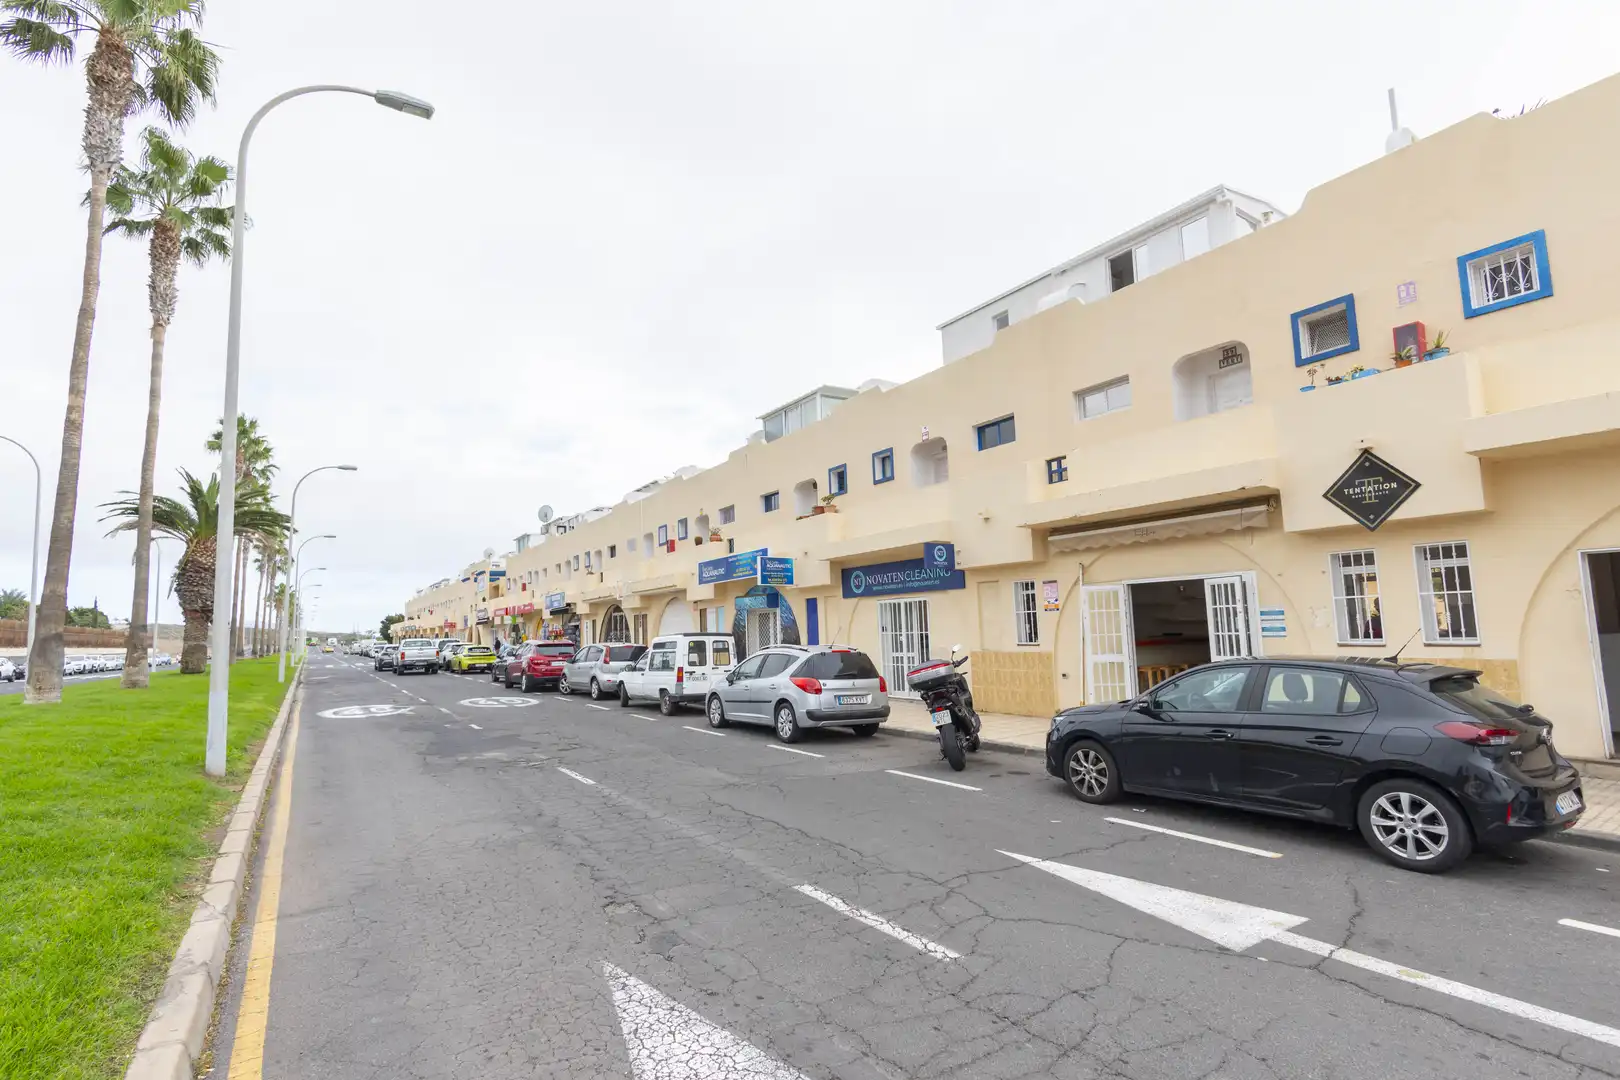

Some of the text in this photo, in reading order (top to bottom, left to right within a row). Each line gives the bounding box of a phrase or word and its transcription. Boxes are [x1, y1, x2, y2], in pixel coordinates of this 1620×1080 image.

[1343, 482, 1398, 495] TENTATION
[853, 577, 863, 586] NT
[866, 567, 951, 586] NOVATEN CLEANING
